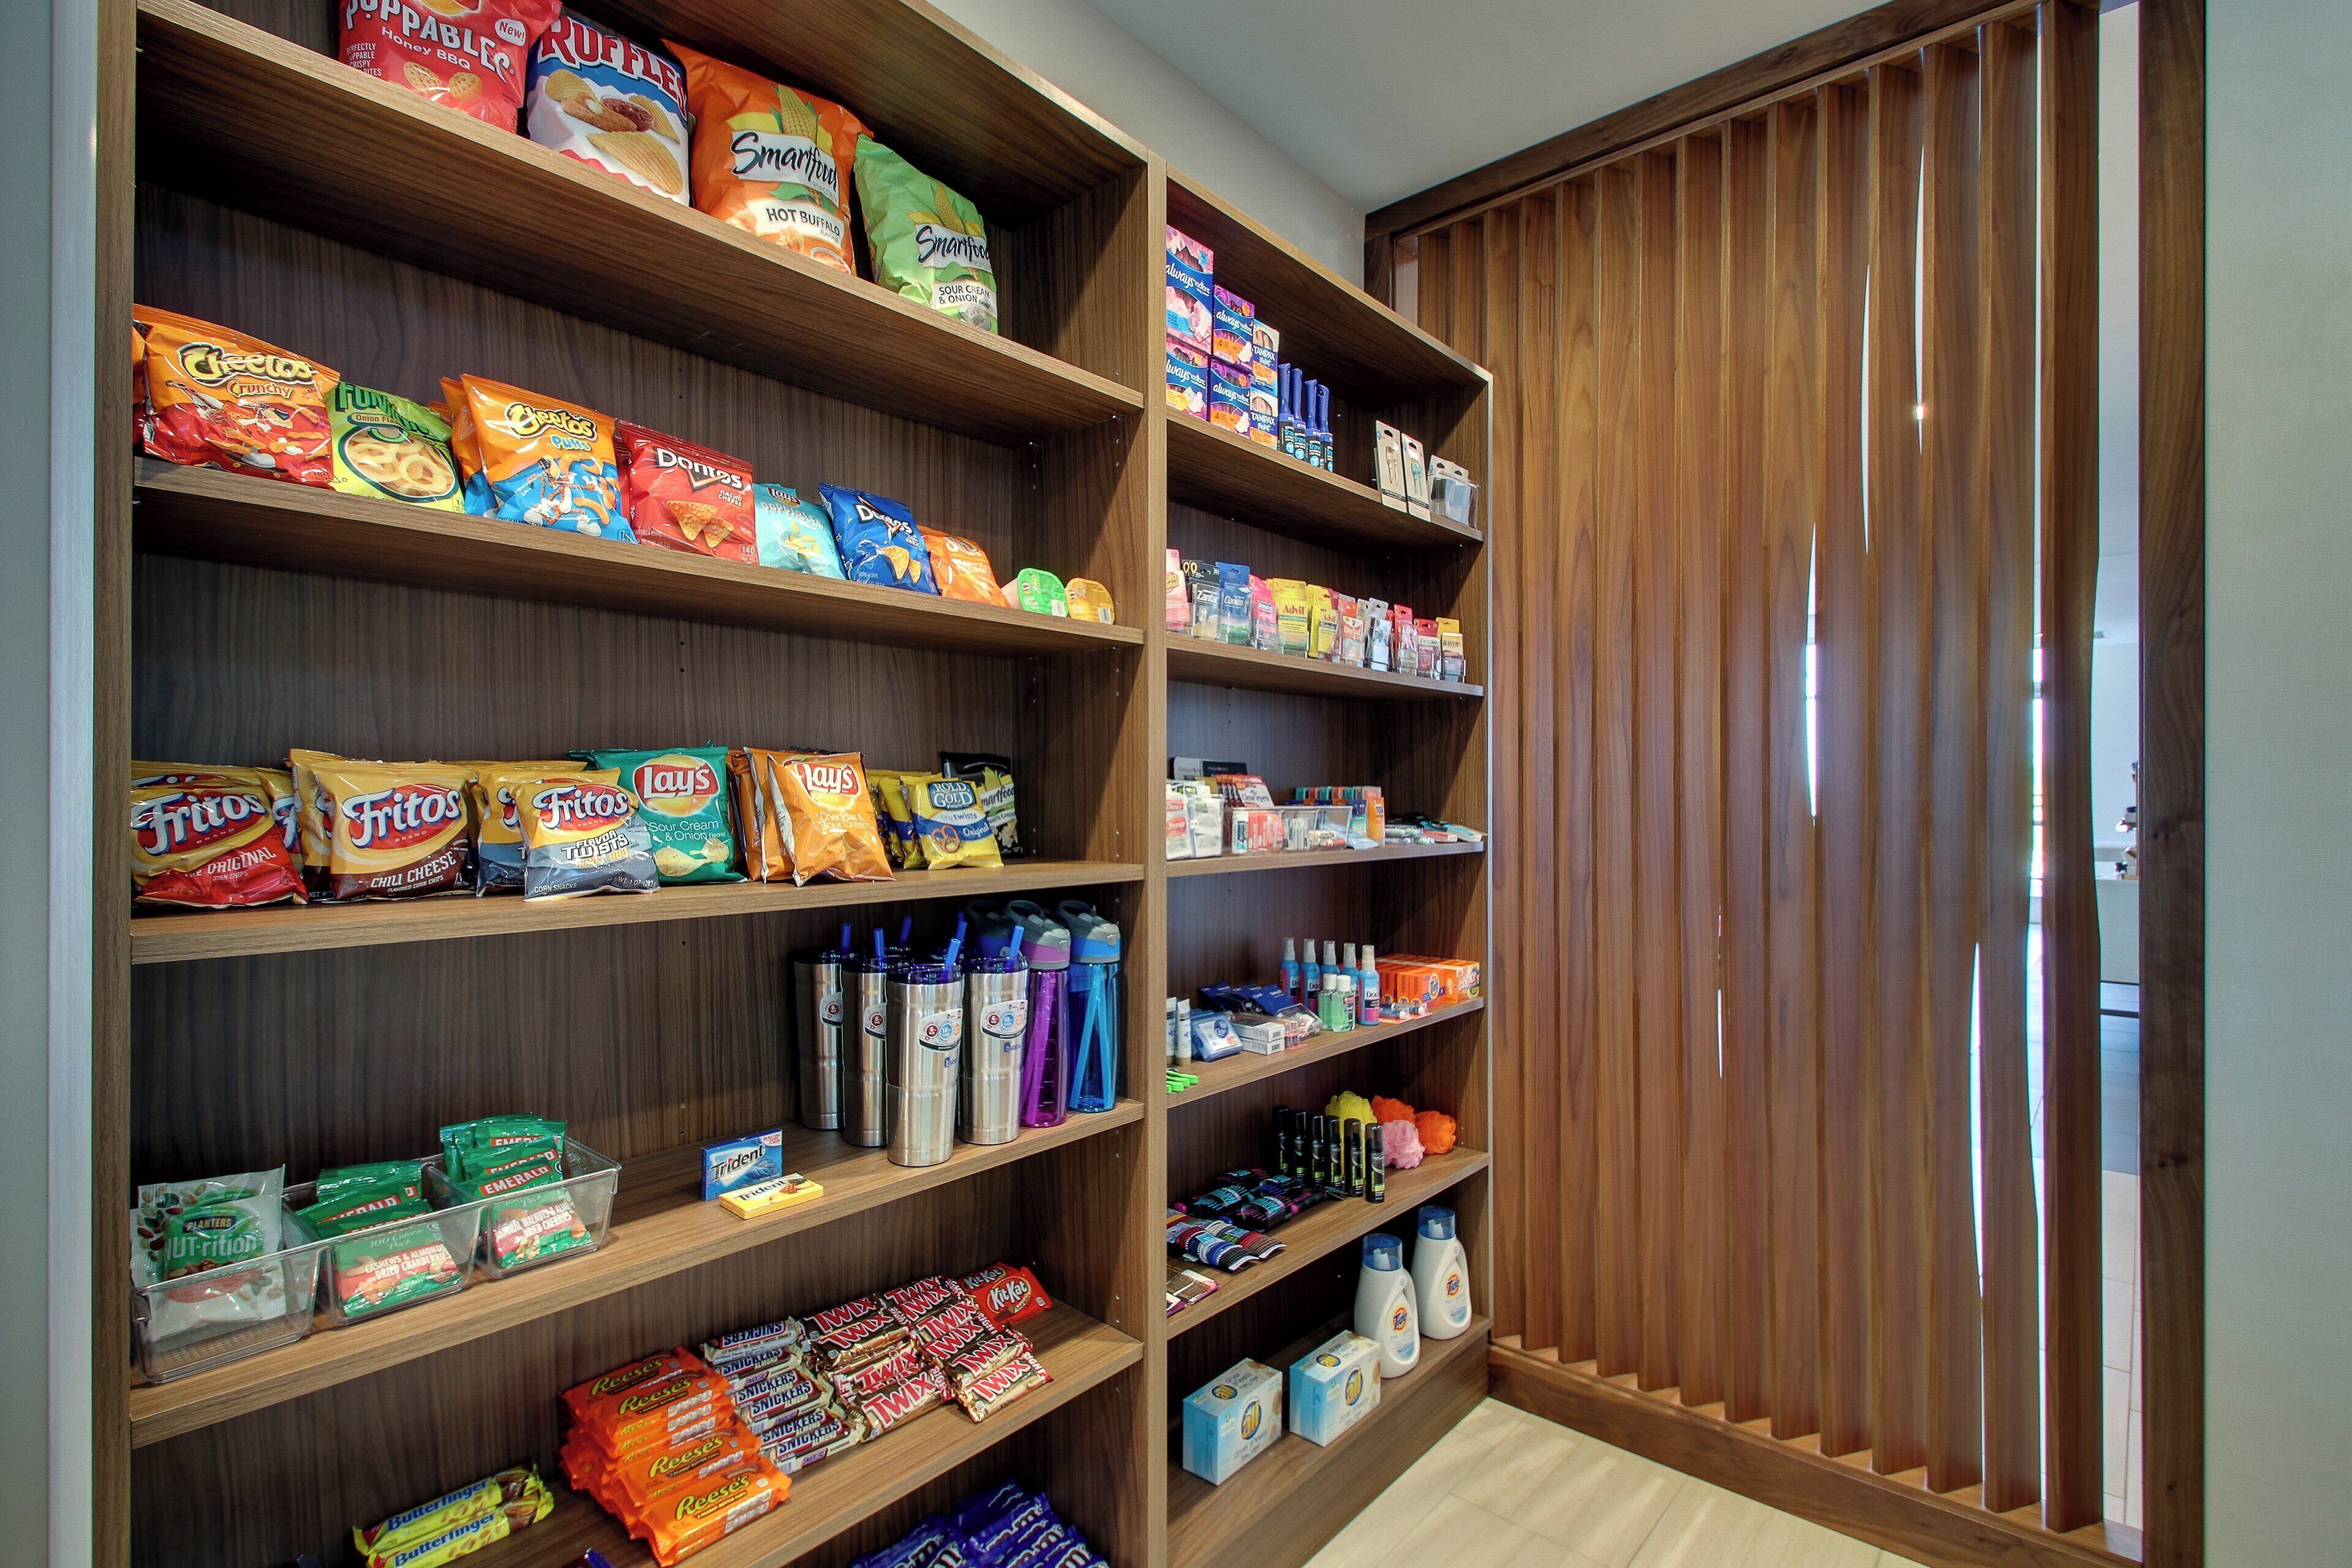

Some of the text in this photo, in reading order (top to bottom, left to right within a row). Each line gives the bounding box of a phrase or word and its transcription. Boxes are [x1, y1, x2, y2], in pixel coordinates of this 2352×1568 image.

[499, 21, 526, 42] New!
[381, 26, 471, 70] Honey BBQ
[541, 15, 687, 119] RUFFLES
[730, 132, 837, 191] Smartfood
[766, 208, 840, 236] HOT BUFFALO
[1166, 263, 1196, 289] always
[939, 285, 990, 299] SOUR CREAM
[948, 295, 977, 303] ONION
[1216, 309, 1240, 331] always
[1253, 345, 1276, 361] TAMPAX
[179, 343, 315, 385] Cheetos
[1166, 359, 1191, 383] lways
[227, 380, 294, 399] Crunchy
[1213, 382, 1237, 402] always
[356, 414, 379, 423] Onion
[506, 403, 596, 440] Cheetos
[1250, 412, 1276, 426] TAMPAX
[550, 434, 592, 451] Puffs
[718, 489, 742, 501] NACHO
[718, 494, 742, 508] CHEESE
[761, 501, 825, 531] POPPABLES
[1283, 605, 1305, 615] Advil
[644, 767, 711, 797] Lay's
[798, 763, 853, 794] Lay's
[933, 782, 968, 792] ROLD
[532, 785, 629, 829] Fritos
[934, 792, 973, 807] GOLD
[1242, 793, 1255, 802] Clear
[130, 791, 267, 856] Fritos
[342, 788, 462, 850] Fritos
[649, 820, 719, 832] Sour Cream
[820, 811, 858, 821] Cheddar
[842, 821, 871, 830] Cream
[940, 812, 978, 822] tiny twists
[196, 827, 235, 844] BRAND
[394, 830, 428, 843] BRAND
[576, 829, 617, 849] FLAVOR
[665, 832, 673, 841] &
[674, 831, 707, 841] Onion
[963, 822, 990, 837] Original
[561, 834, 630, 861] TWISTS
[610, 848, 629, 861] BBQ
[207, 846, 277, 875] ORIGINAL
[370, 850, 458, 889] CHILI CHEESE
[230, 870, 249, 880] CHIPS
[412, 880, 428, 889] CORN
[428, 873, 445, 885] CHIPS
[534, 882, 578, 894] CORN SNACKS
[710, 1143, 766, 1181] Trident
[484, 1166, 549, 1194] EMERALD
[522, 1194, 542, 1207] Pack
[733, 1180, 786, 1201] Trident
[187, 1218, 232, 1231] PLANTERS
[522, 1212, 572, 1238] DRIED CHERRIES
[370, 1229, 423, 1248] 100 Calorie
[387, 1240, 412, 1251] Pack
[364, 1256, 401, 1274] CASHEWS
[410, 1243, 447, 1259] ALMONDS
[374, 1251, 452, 1281] DRIED CRANBERRIES
[1446, 1279, 1460, 1295] Tide
[1393, 1313, 1407, 1330] Tide
[723, 1321, 785, 1348] SNICKERS
[723, 1348, 782, 1374] SNICKERS
[754, 1357, 778, 1369] ALMOND
[1319, 1352, 1338, 1368] all
[590, 1359, 663, 1396] Reese's
[737, 1371, 797, 1402] SNICKERS
[619, 1379, 693, 1415] Reese's
[752, 1381, 812, 1415] SNICKERS
[769, 1382, 794, 1396] ALMOND
[1215, 1384, 1236, 1400] all
[1346, 1370, 1362, 1406] all
[784, 1393, 809, 1408] ALMOND
[763, 1410, 824, 1442] SNICKERS
[795, 1421, 821, 1434] ALMOND
[1242, 1400, 1260, 1439] all
[778, 1422, 840, 1454] SNICKERS
[812, 1431, 837, 1447] ALMOND
[649, 1436, 724, 1479] Reese's
[386, 1479, 488, 1532] Butterfinger
[676, 1474, 750, 1521] Reese's
[393, 1512, 496, 1568] Butterfinger
